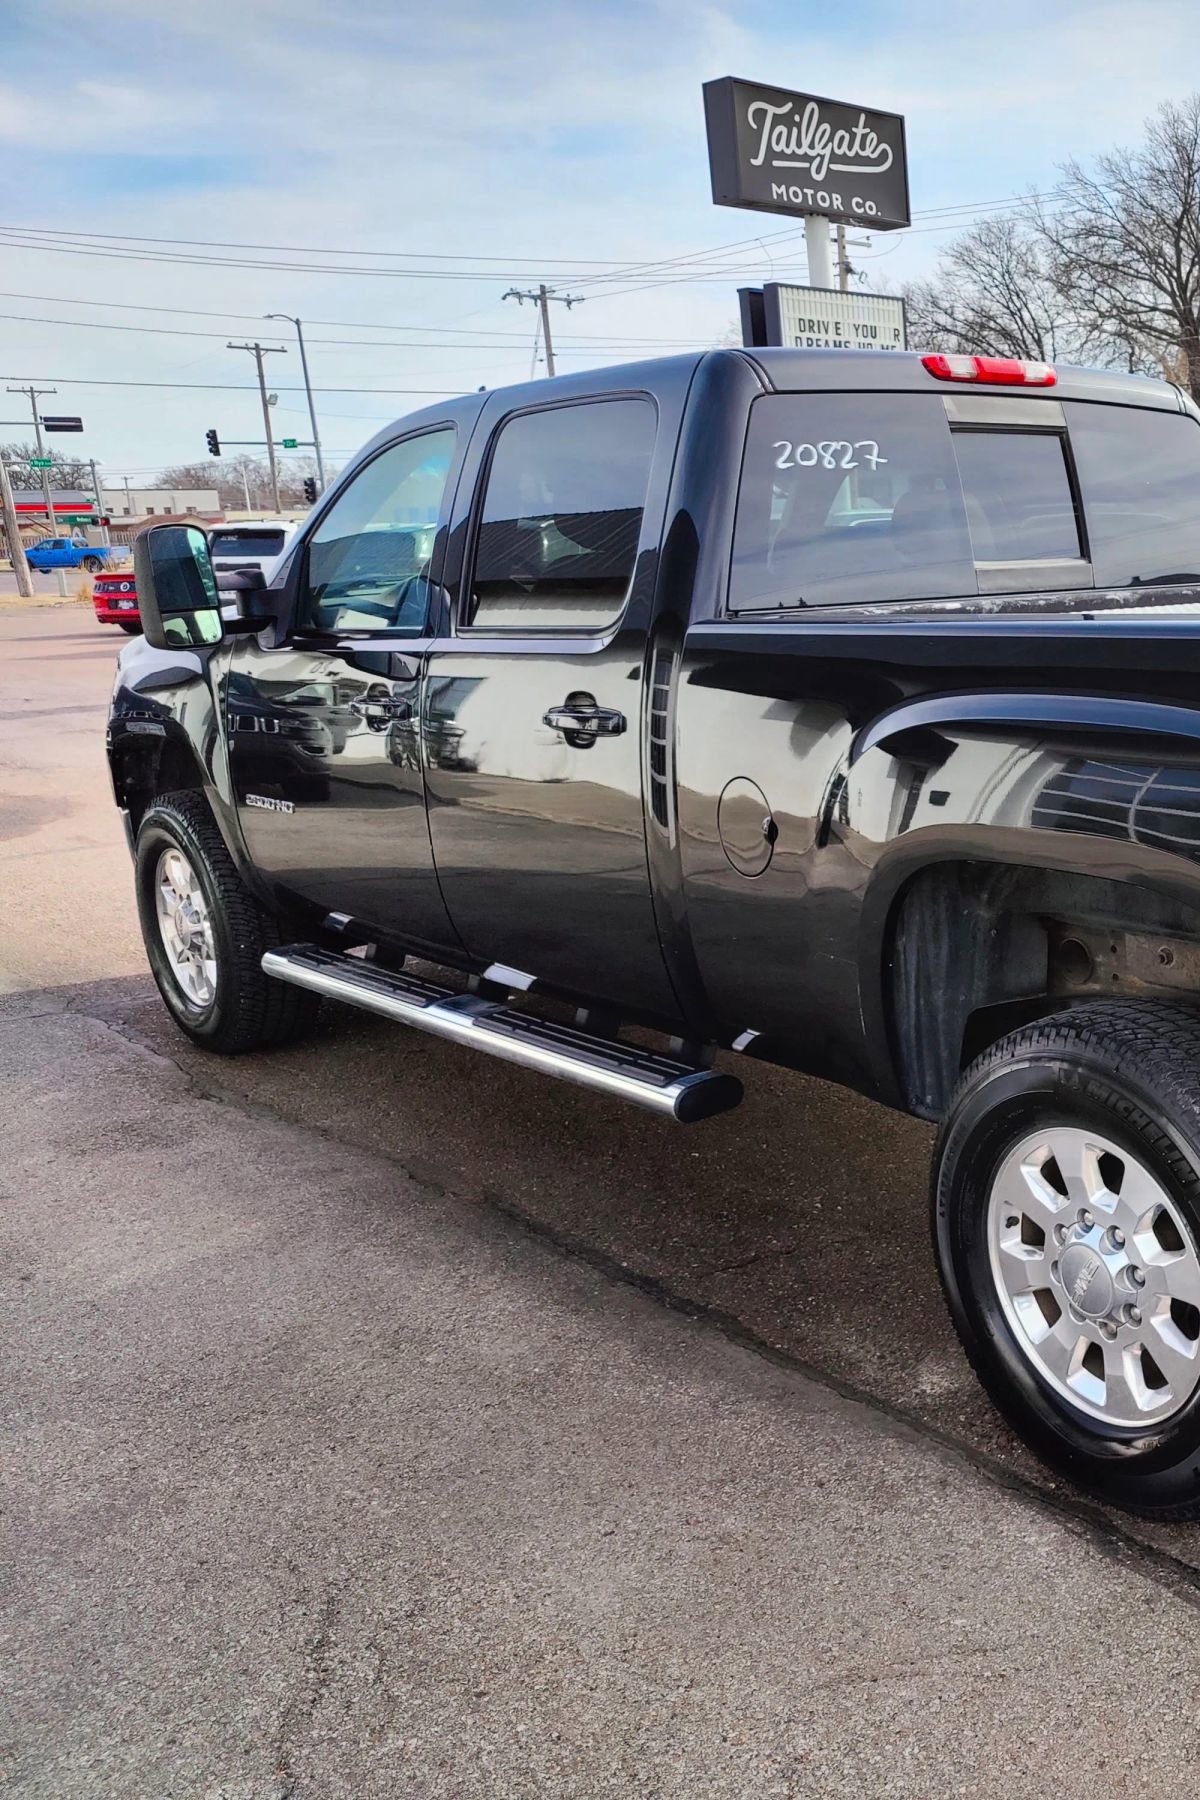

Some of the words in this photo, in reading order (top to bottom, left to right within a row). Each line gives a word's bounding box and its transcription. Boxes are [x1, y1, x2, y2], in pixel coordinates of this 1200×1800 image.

[747, 101, 893, 181] Tailgate
[771, 183, 844, 211] MOTOR
[852, 196, 882, 216] CO.
[798, 317, 842, 336] DRIVE
[773, 440, 888, 471] 20827
[1086, 1079, 1200, 1184] MICHELIN
